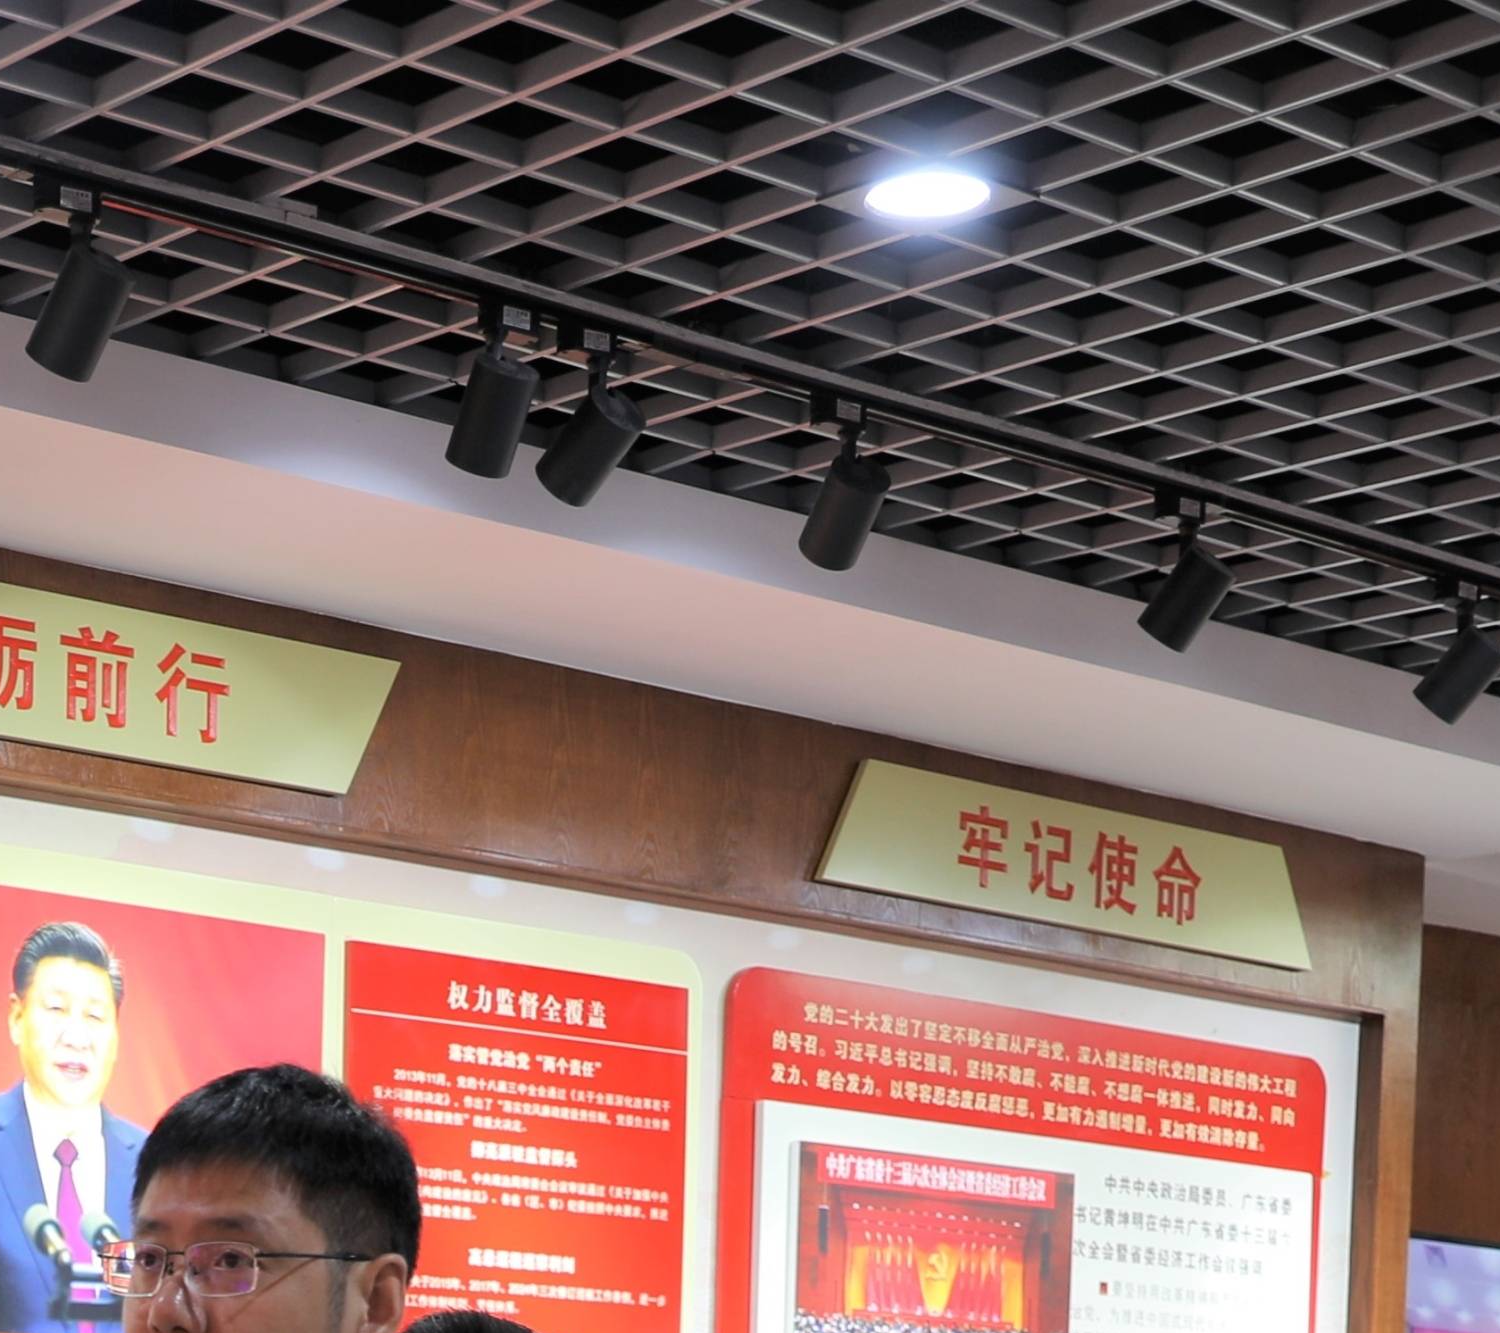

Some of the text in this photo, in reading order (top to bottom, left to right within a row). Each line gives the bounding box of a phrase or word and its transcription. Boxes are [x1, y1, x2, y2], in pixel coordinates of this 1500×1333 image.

[956, 805, 1204, 928] 牢记使命
[447, 979, 607, 1030] 权力监督全覆盖
